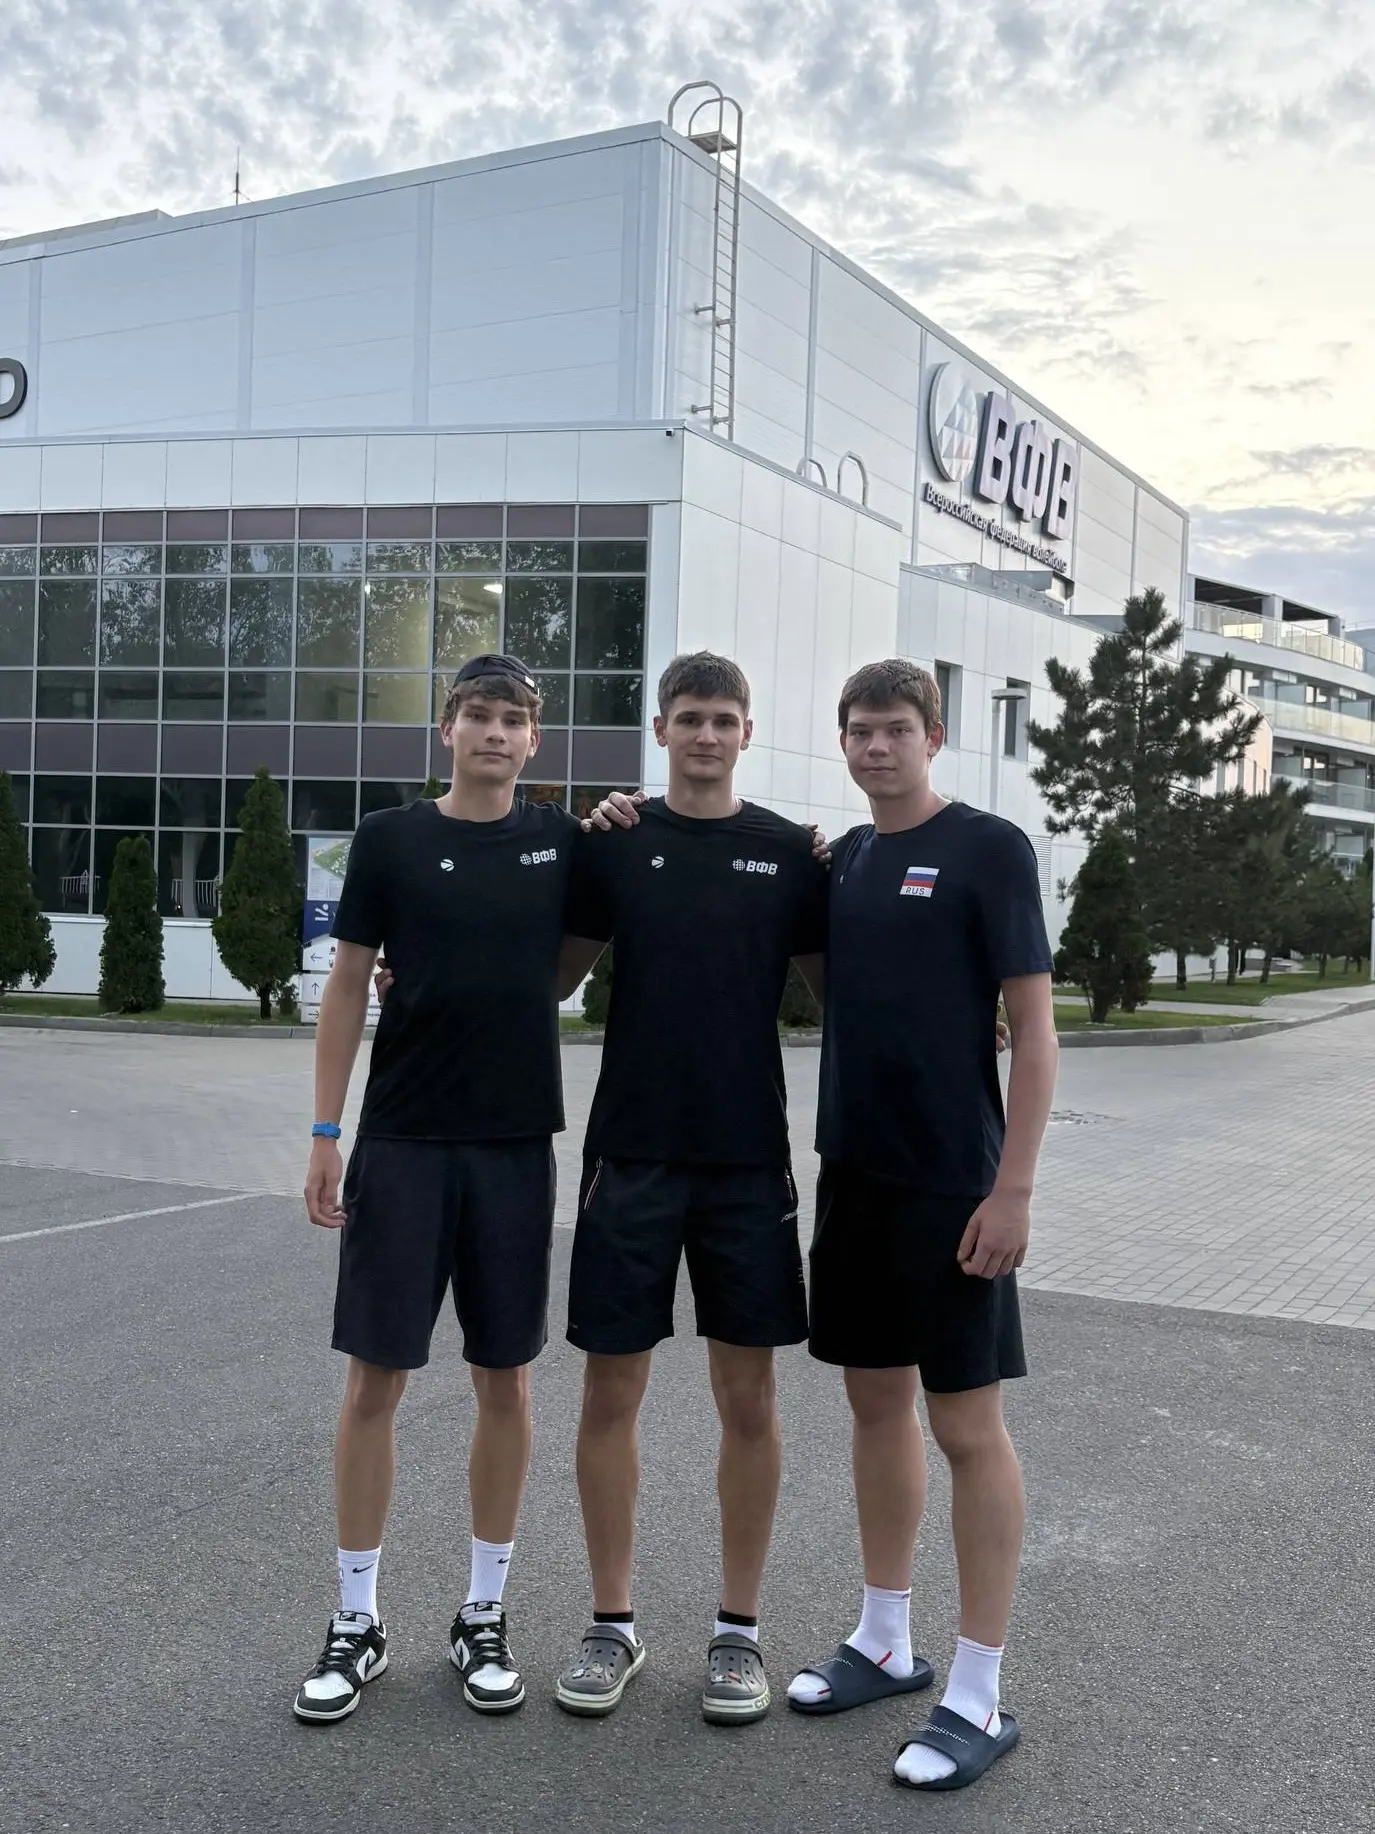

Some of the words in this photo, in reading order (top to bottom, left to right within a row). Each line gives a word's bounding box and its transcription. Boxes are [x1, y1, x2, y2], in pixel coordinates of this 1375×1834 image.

[974, 391, 1079, 540] ВФВ
[923, 482, 988, 533] Всероссийская
[532, 848, 557, 864] ВФВ
[746, 860, 778, 875] ВФВ
[906, 887, 925, 895] RUS
